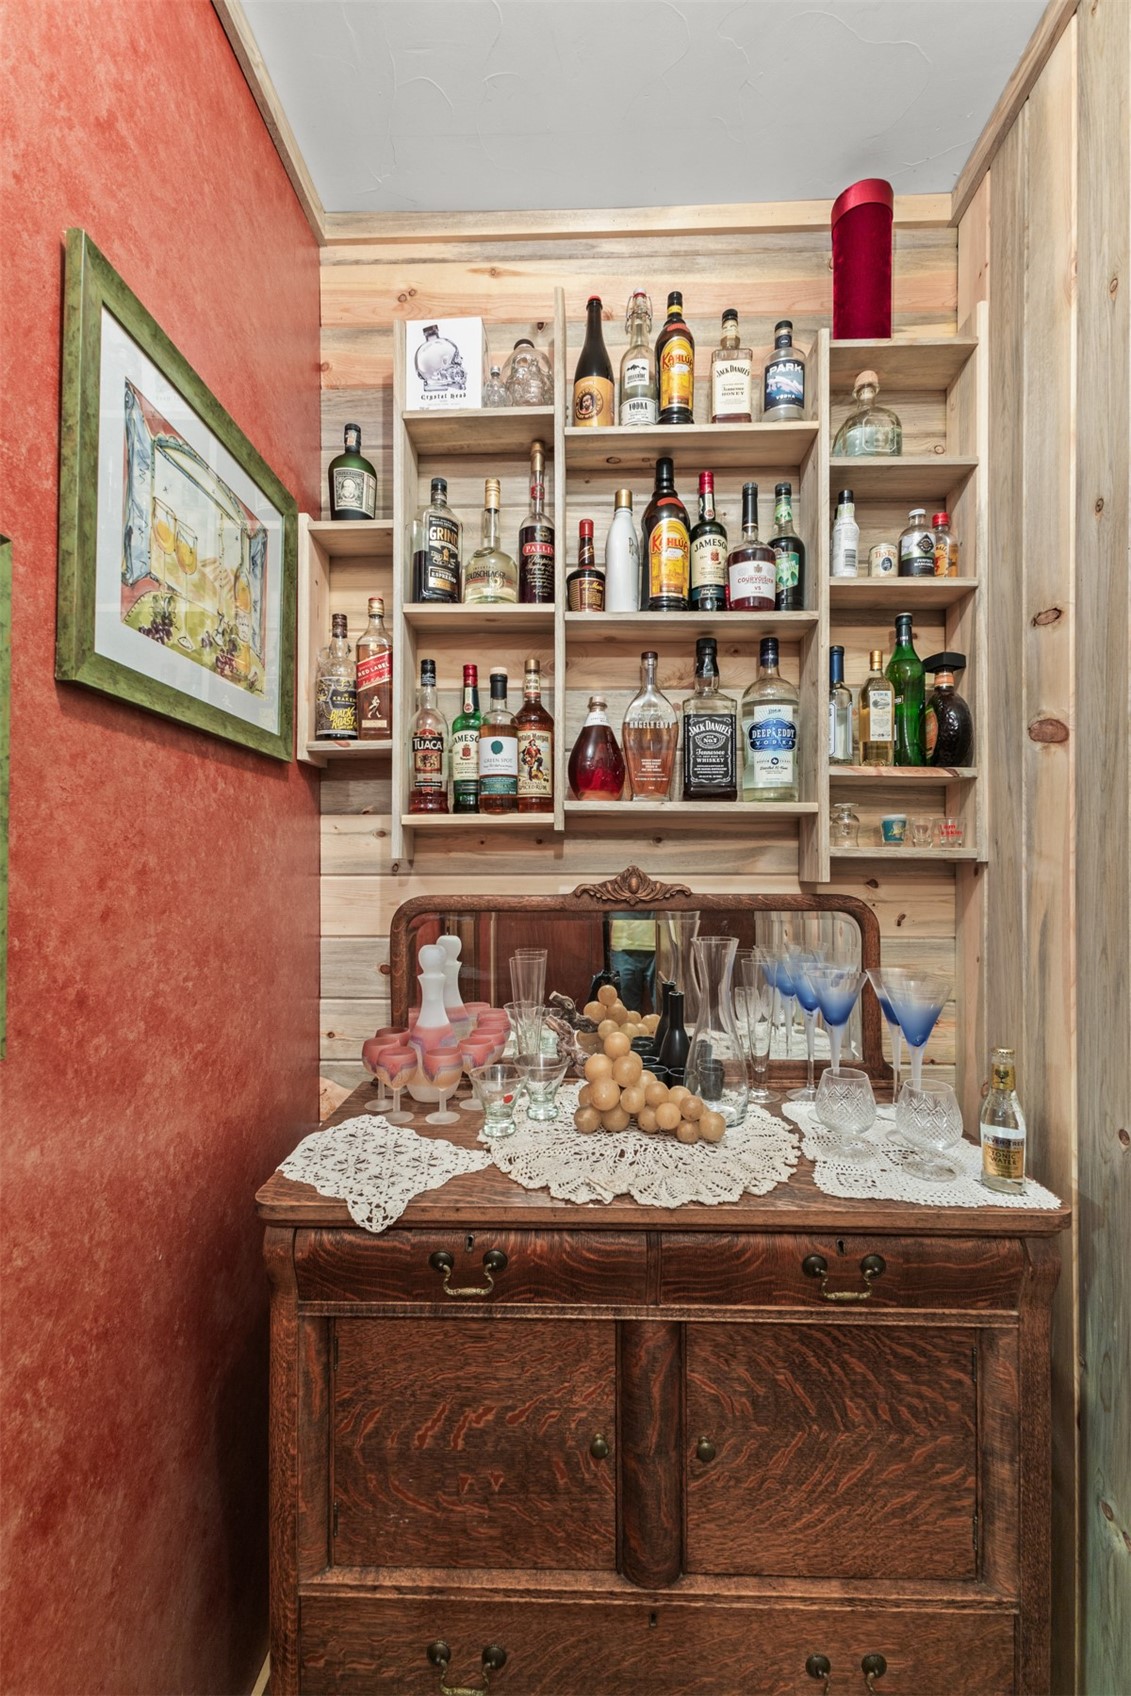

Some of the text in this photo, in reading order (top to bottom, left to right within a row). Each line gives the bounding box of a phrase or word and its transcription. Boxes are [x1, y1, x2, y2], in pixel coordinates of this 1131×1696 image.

[769, 362, 803, 376] PARK
[420, 393, 448, 401] Crystal
[628, 401, 648, 412] VODKA
[357, 661, 390, 678] RED LABEL
[329, 705, 356, 721] BLACK
[331, 716, 355, 730] ROAST
[688, 720, 733, 737] JACK DANIEL'S
[752, 728, 795, 739] DEEP EDDY
[413, 739, 443, 750] TUACA
[990, 1155, 1017, 1166] WATER
[991, 1150, 1017, 1160] TONIC
